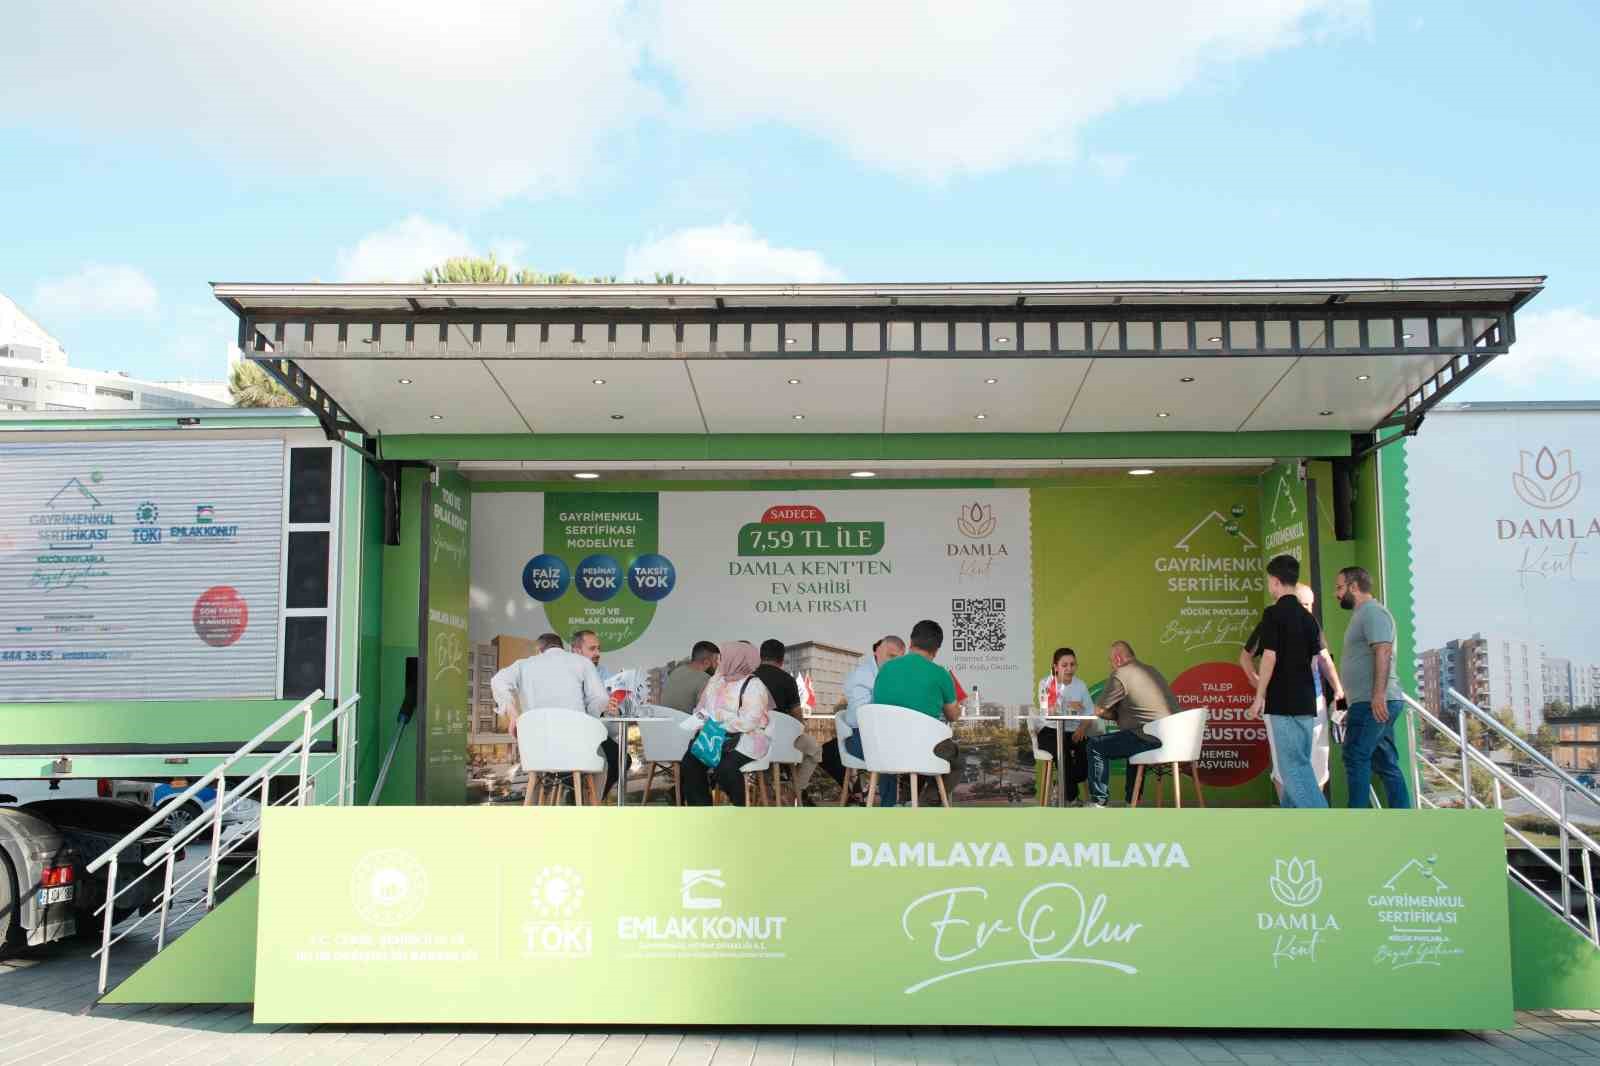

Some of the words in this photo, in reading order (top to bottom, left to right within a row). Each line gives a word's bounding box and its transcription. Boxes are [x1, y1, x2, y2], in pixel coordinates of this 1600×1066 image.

[29, 511, 115, 525] GAYRİMENKUL
[559, 511, 643, 521] GAYRİMENKUL
[770, 509, 817, 519] SADECE
[565, 524, 636, 535] SERTİFİKASI
[1496, 518, 1600, 540] DAMLA
[567, 537, 636, 548] MODELİYLE
[750, 530, 794, 550] 7,59
[800, 531, 829, 548] TL
[836, 526, 873, 548] İLE
[947, 544, 1009, 556] DAMLA
[728, 560, 798, 576] DAMLA
[801, 560, 892, 576] KENT'TEN
[1155, 554, 1264, 572] GAYRİMENKU
[1516, 542, 1589, 590] Kent
[532, 567, 560, 578] FAİZ
[635, 567, 668, 576] TAKSİT
[533, 580, 560, 589] YOK
[583, 577, 616, 588] YOK
[635, 576, 668, 588] YOK
[771, 582, 792, 594] EV
[796, 578, 852, 594] SAHİBİ
[1168, 574, 1264, 592] SERTİFİKAS
[607, 607, 620, 615] VE
[755, 600, 802, 613] OLMA
[807, 600, 867, 613] FIRSATI
[602, 617, 635, 625] KONUT
[1202, 683, 1233, 692] TALEP
[1177, 695, 1225, 704] TOPLAMA
[1227, 693, 1257, 704] TARİH
[1202, 725, 1267, 740] ĞUSTOS
[1202, 751, 1239, 759] HEMEN
[849, 841, 1014, 868] DAMLAYA
[1024, 841, 1191, 868] DAMLAYA
[1368, 892, 1465, 908] GAYRİMENKUL
[902, 886, 1012, 961] Ev
[1017, 882, 1144, 960] Olur
[1256, 912, 1340, 930] DAMLA
[1377, 909, 1457, 924] SERTİFİKASI
[617, 916, 699, 940] EMLAK
[701, 916, 786, 940] KONUT
[1272, 931, 1326, 968] Kent
